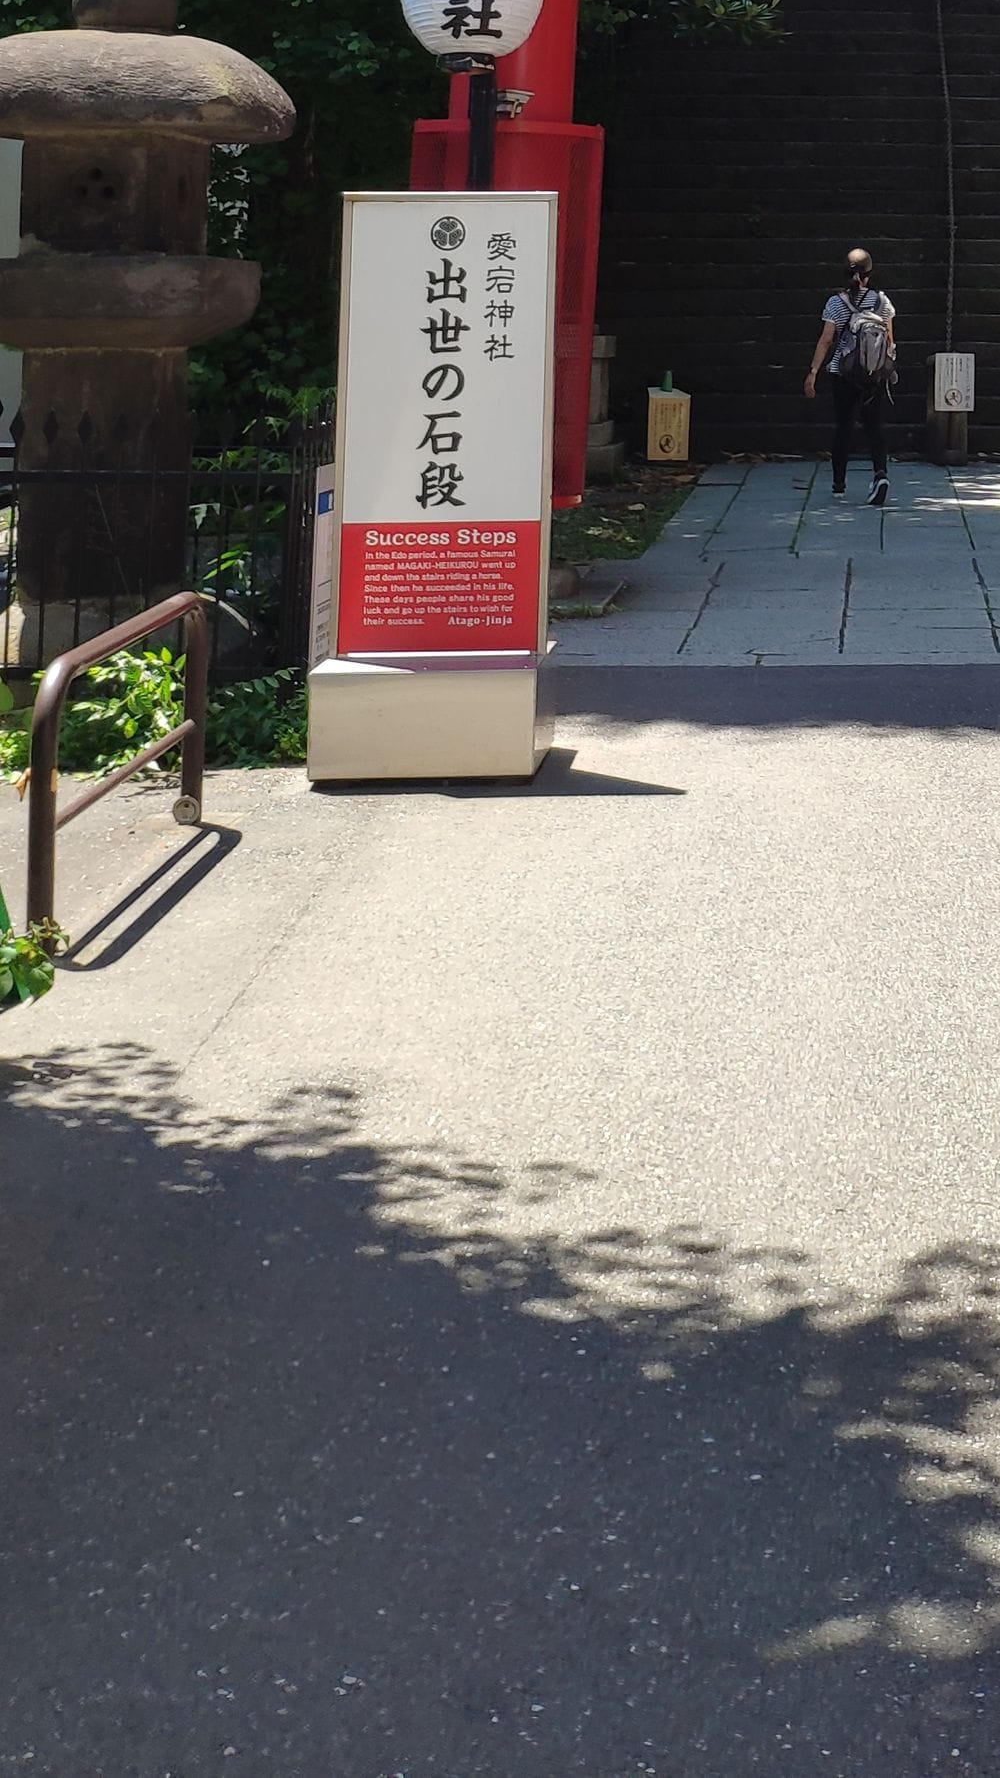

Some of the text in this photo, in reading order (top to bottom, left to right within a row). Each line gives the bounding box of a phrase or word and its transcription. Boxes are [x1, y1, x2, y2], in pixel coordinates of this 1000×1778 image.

[483, 232, 517, 361] 愛宕神社
[416, 258, 471, 509] 出世の石段
[365, 529, 517, 546] Success Steps
[364, 584, 388, 592] Since
[364, 595, 390, 603] These
[492, 594, 514, 602] good
[363, 606, 381, 615] luck
[448, 616, 513, 627] Atago-Jinja
